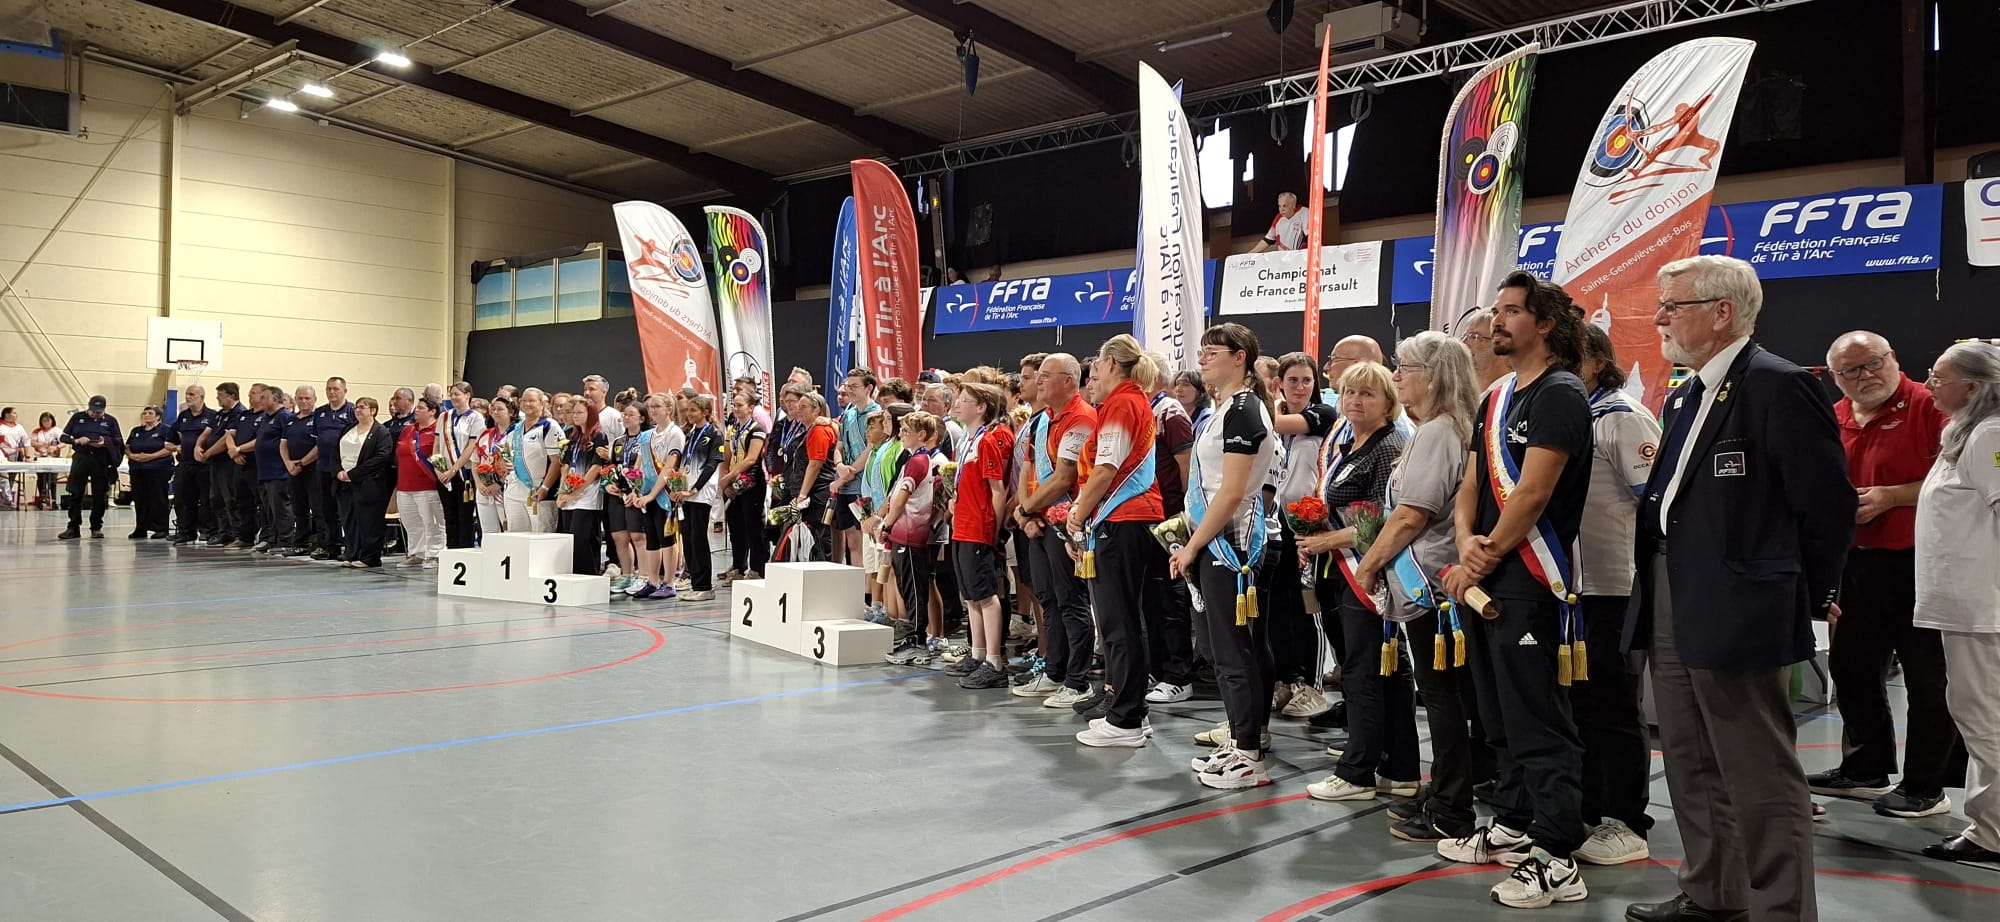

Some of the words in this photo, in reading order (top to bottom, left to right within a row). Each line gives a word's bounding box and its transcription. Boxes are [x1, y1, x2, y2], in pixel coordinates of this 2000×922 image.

[872, 205, 889, 267] l'Arc
[1565, 232, 1621, 274] Archers
[1622, 216, 1643, 235] du
[1645, 182, 1699, 220] donjon
[889, 244, 897, 256] Tir
[1754, 239, 1826, 252] Fédération
[1829, 233, 1900, 248] Française
[891, 260, 898, 272] de
[1580, 219, 1693, 295] Sainte-Geneviève-des-Bois
[1751, 253, 1767, 263] de
[1771, 251, 1789, 262] Tir
[1791, 250, 1800, 261] à
[1803, 248, 1835, 260] l'Arc
[1865, 254, 1933, 268] www.ffta.fr
[874, 277, 891, 292] à
[1258, 264, 1336, 282] Championat
[1240, 286, 1253, 297] de
[1256, 284, 1296, 297] France
[876, 300, 893, 338] Tir
[986, 305, 1016, 314] Fédération
[1017, 303, 1045, 312] Française
[762, 373, 770, 409] FRANCE
[453, 562, 467, 586] 2
[500, 556, 510, 580] 1
[543, 579, 557, 603] 3
[742, 597, 753, 627] 2
[778, 592, 787, 623] 1
[813, 626, 825, 659] 3
